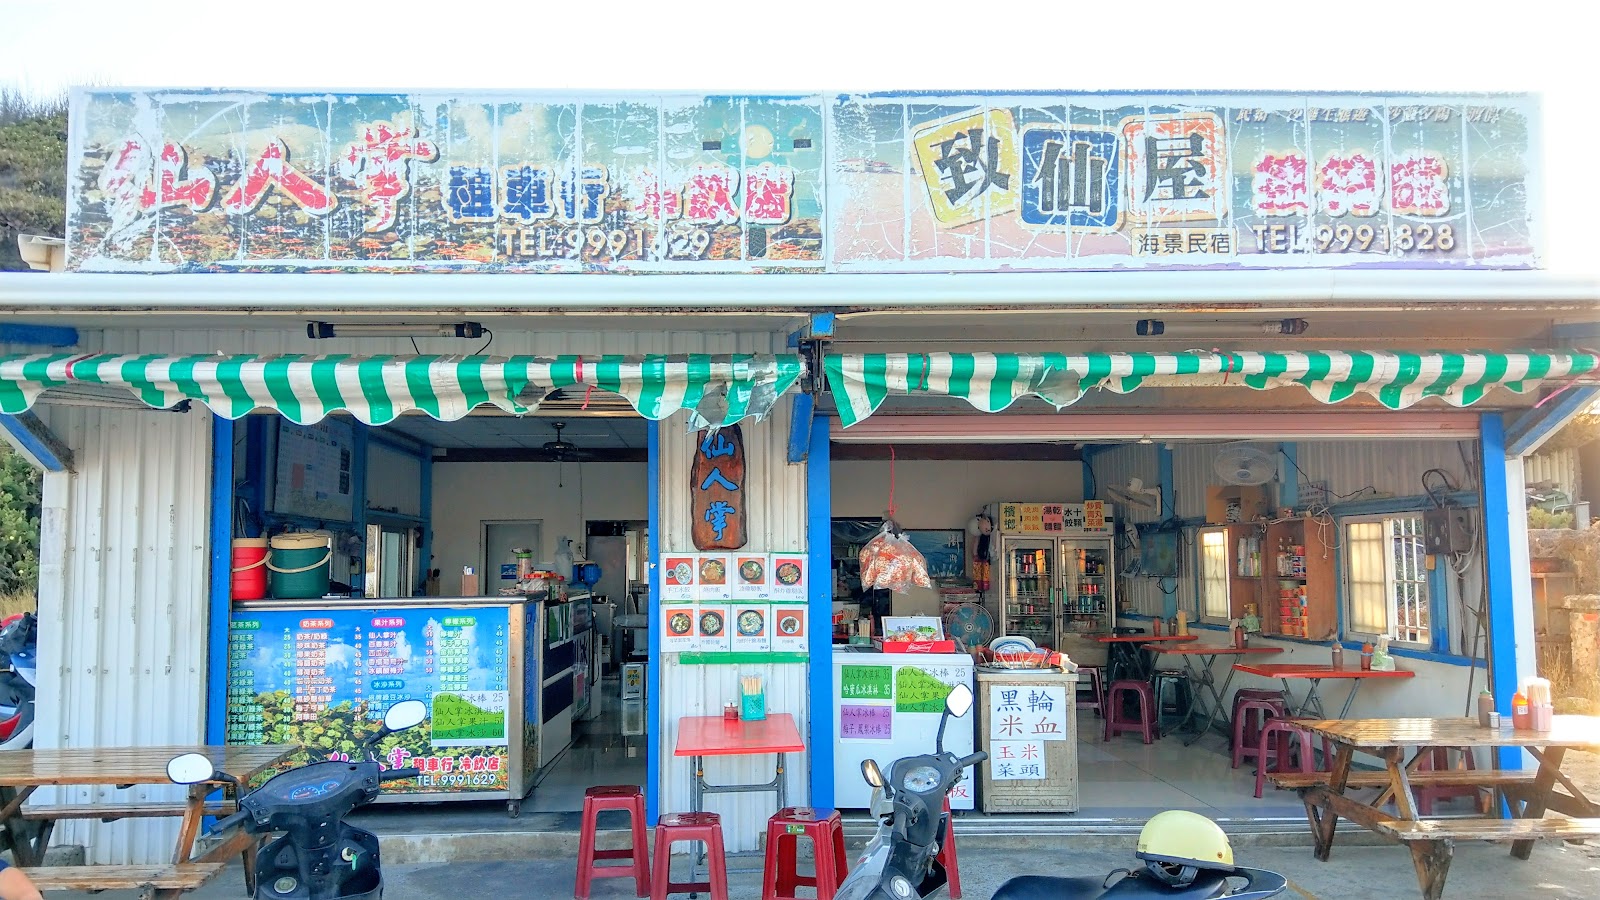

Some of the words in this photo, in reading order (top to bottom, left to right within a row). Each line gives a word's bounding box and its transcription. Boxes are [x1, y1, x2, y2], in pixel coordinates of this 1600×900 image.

[100, 119, 437, 233] 仙人掌
[1137, 232, 1231, 256] 海景民宿
[700, 433, 739, 541] 仙人掌
[1003, 505, 1016, 531] 檳榔
[843, 668, 881, 681] 仙人掌冰淇淋
[882, 667, 890, 680] 35
[898, 667, 950, 678] 仙人掌冰棒
[954, 667, 966, 678] 25
[883, 683, 891, 695] 35
[435, 694, 488, 703] 仙人掌冰棒
[492, 693, 503, 702] 25
[996, 689, 1055, 712] 黑輪
[842, 707, 875, 718] 仙人掌冰棒
[882, 708, 890, 718] 25
[435, 717, 488, 726] 仙人掌果汁
[999, 715, 1062, 737] 米血
[435, 729, 486, 738] 仙人掌冰沙
[996, 743, 1038, 760] 玉米
[412, 757, 454, 772] 租車行
[459, 756, 500, 772] 冷飲店
[996, 763, 1040, 777] 菜頭
[416, 774, 496, 786] TEL:9991629
